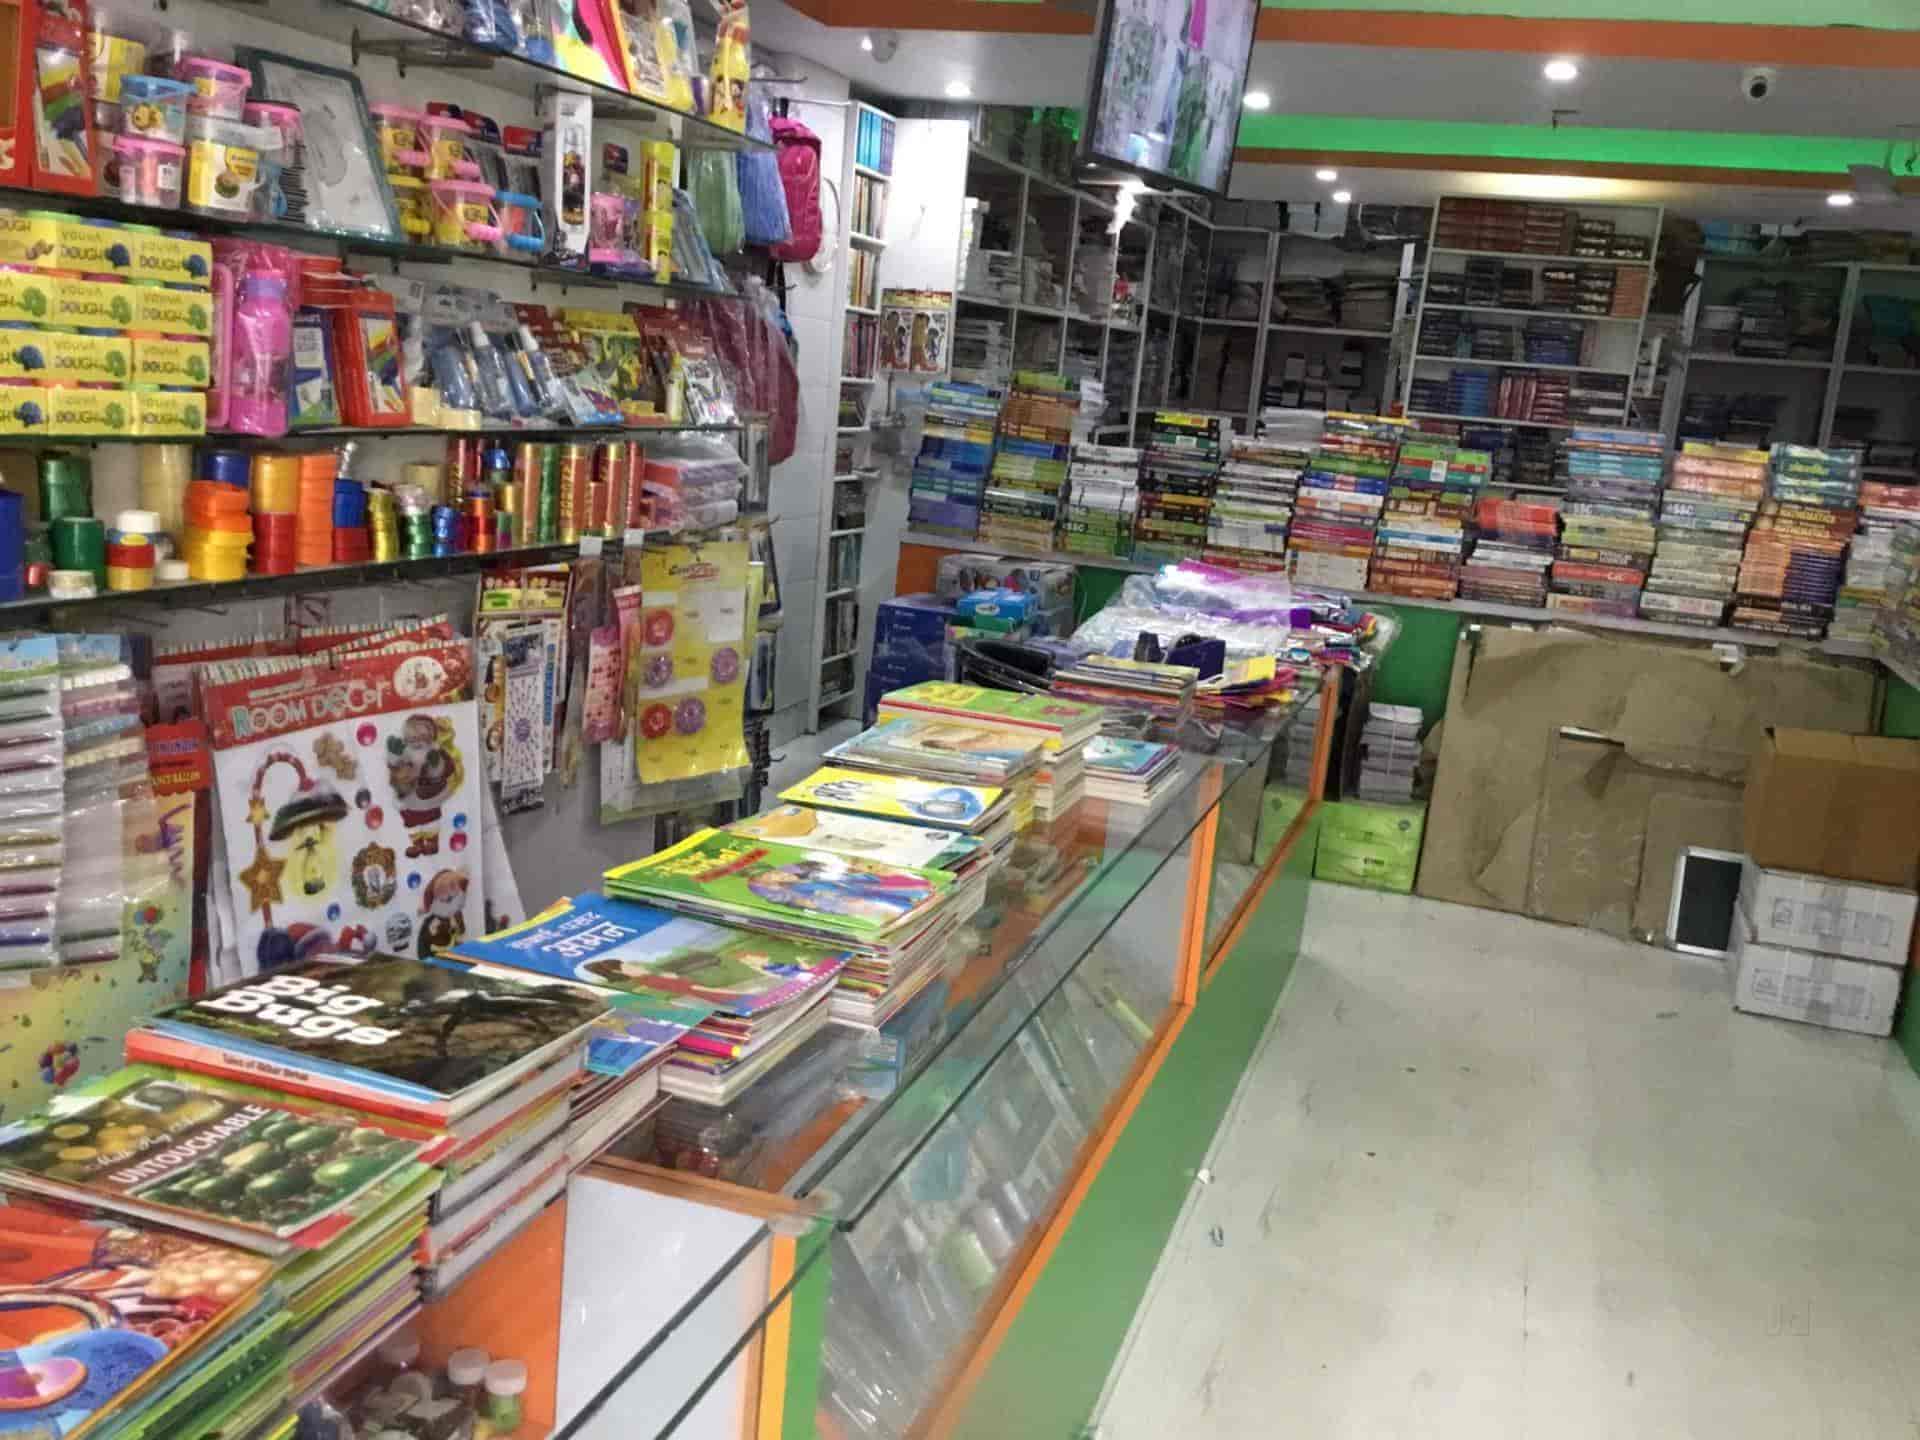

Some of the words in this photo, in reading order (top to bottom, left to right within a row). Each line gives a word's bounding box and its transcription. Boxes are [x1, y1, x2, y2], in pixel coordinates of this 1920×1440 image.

[60, 245, 101, 260] DOUGH
[139, 256, 182, 272] DOUGH
[59, 299, 104, 316] DOUGH
[55, 356, 96, 370] DOUGH
[142, 361, 181, 374] DOUGH
[55, 410, 96, 424] DOUGH
[231, 698, 307, 740] ROOM
[243, 974, 386, 1016] Big
[194, 989, 403, 1045] Bugs
[108, 1102, 272, 1185] UNTOUCHABLE
